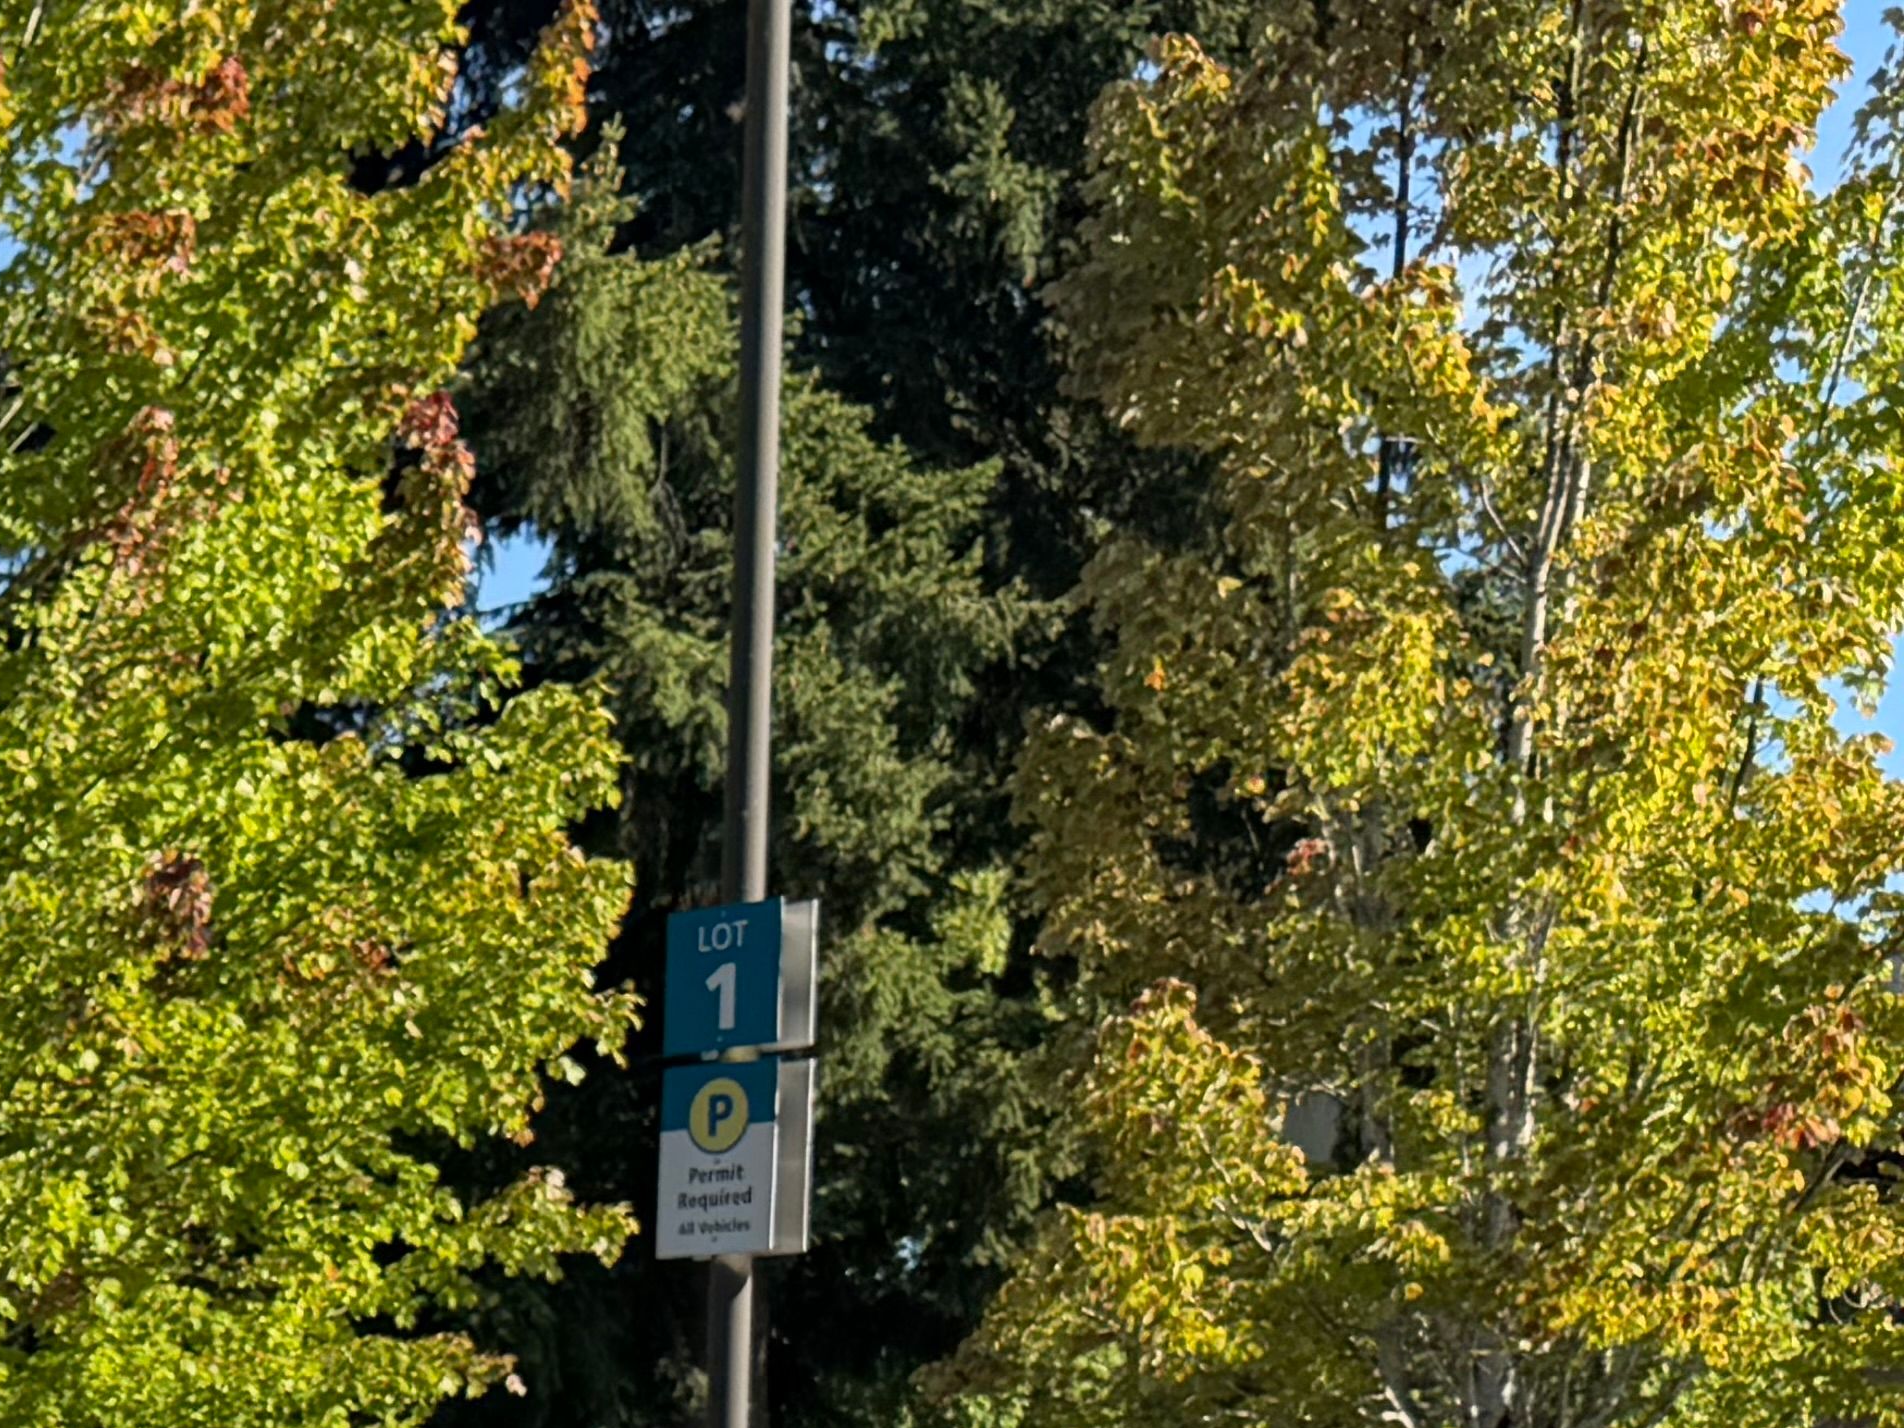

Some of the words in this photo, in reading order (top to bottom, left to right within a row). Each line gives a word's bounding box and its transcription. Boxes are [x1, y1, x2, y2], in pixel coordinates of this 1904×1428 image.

[698, 919, 748, 953] LOT
[705, 962, 737, 1030] 1
[706, 1093, 734, 1137] P
[688, 1163, 744, 1185] Permit
[677, 1186, 752, 1213] Required
[678, 1221, 695, 1235] All
[698, 1217, 751, 1235] Vehicles
